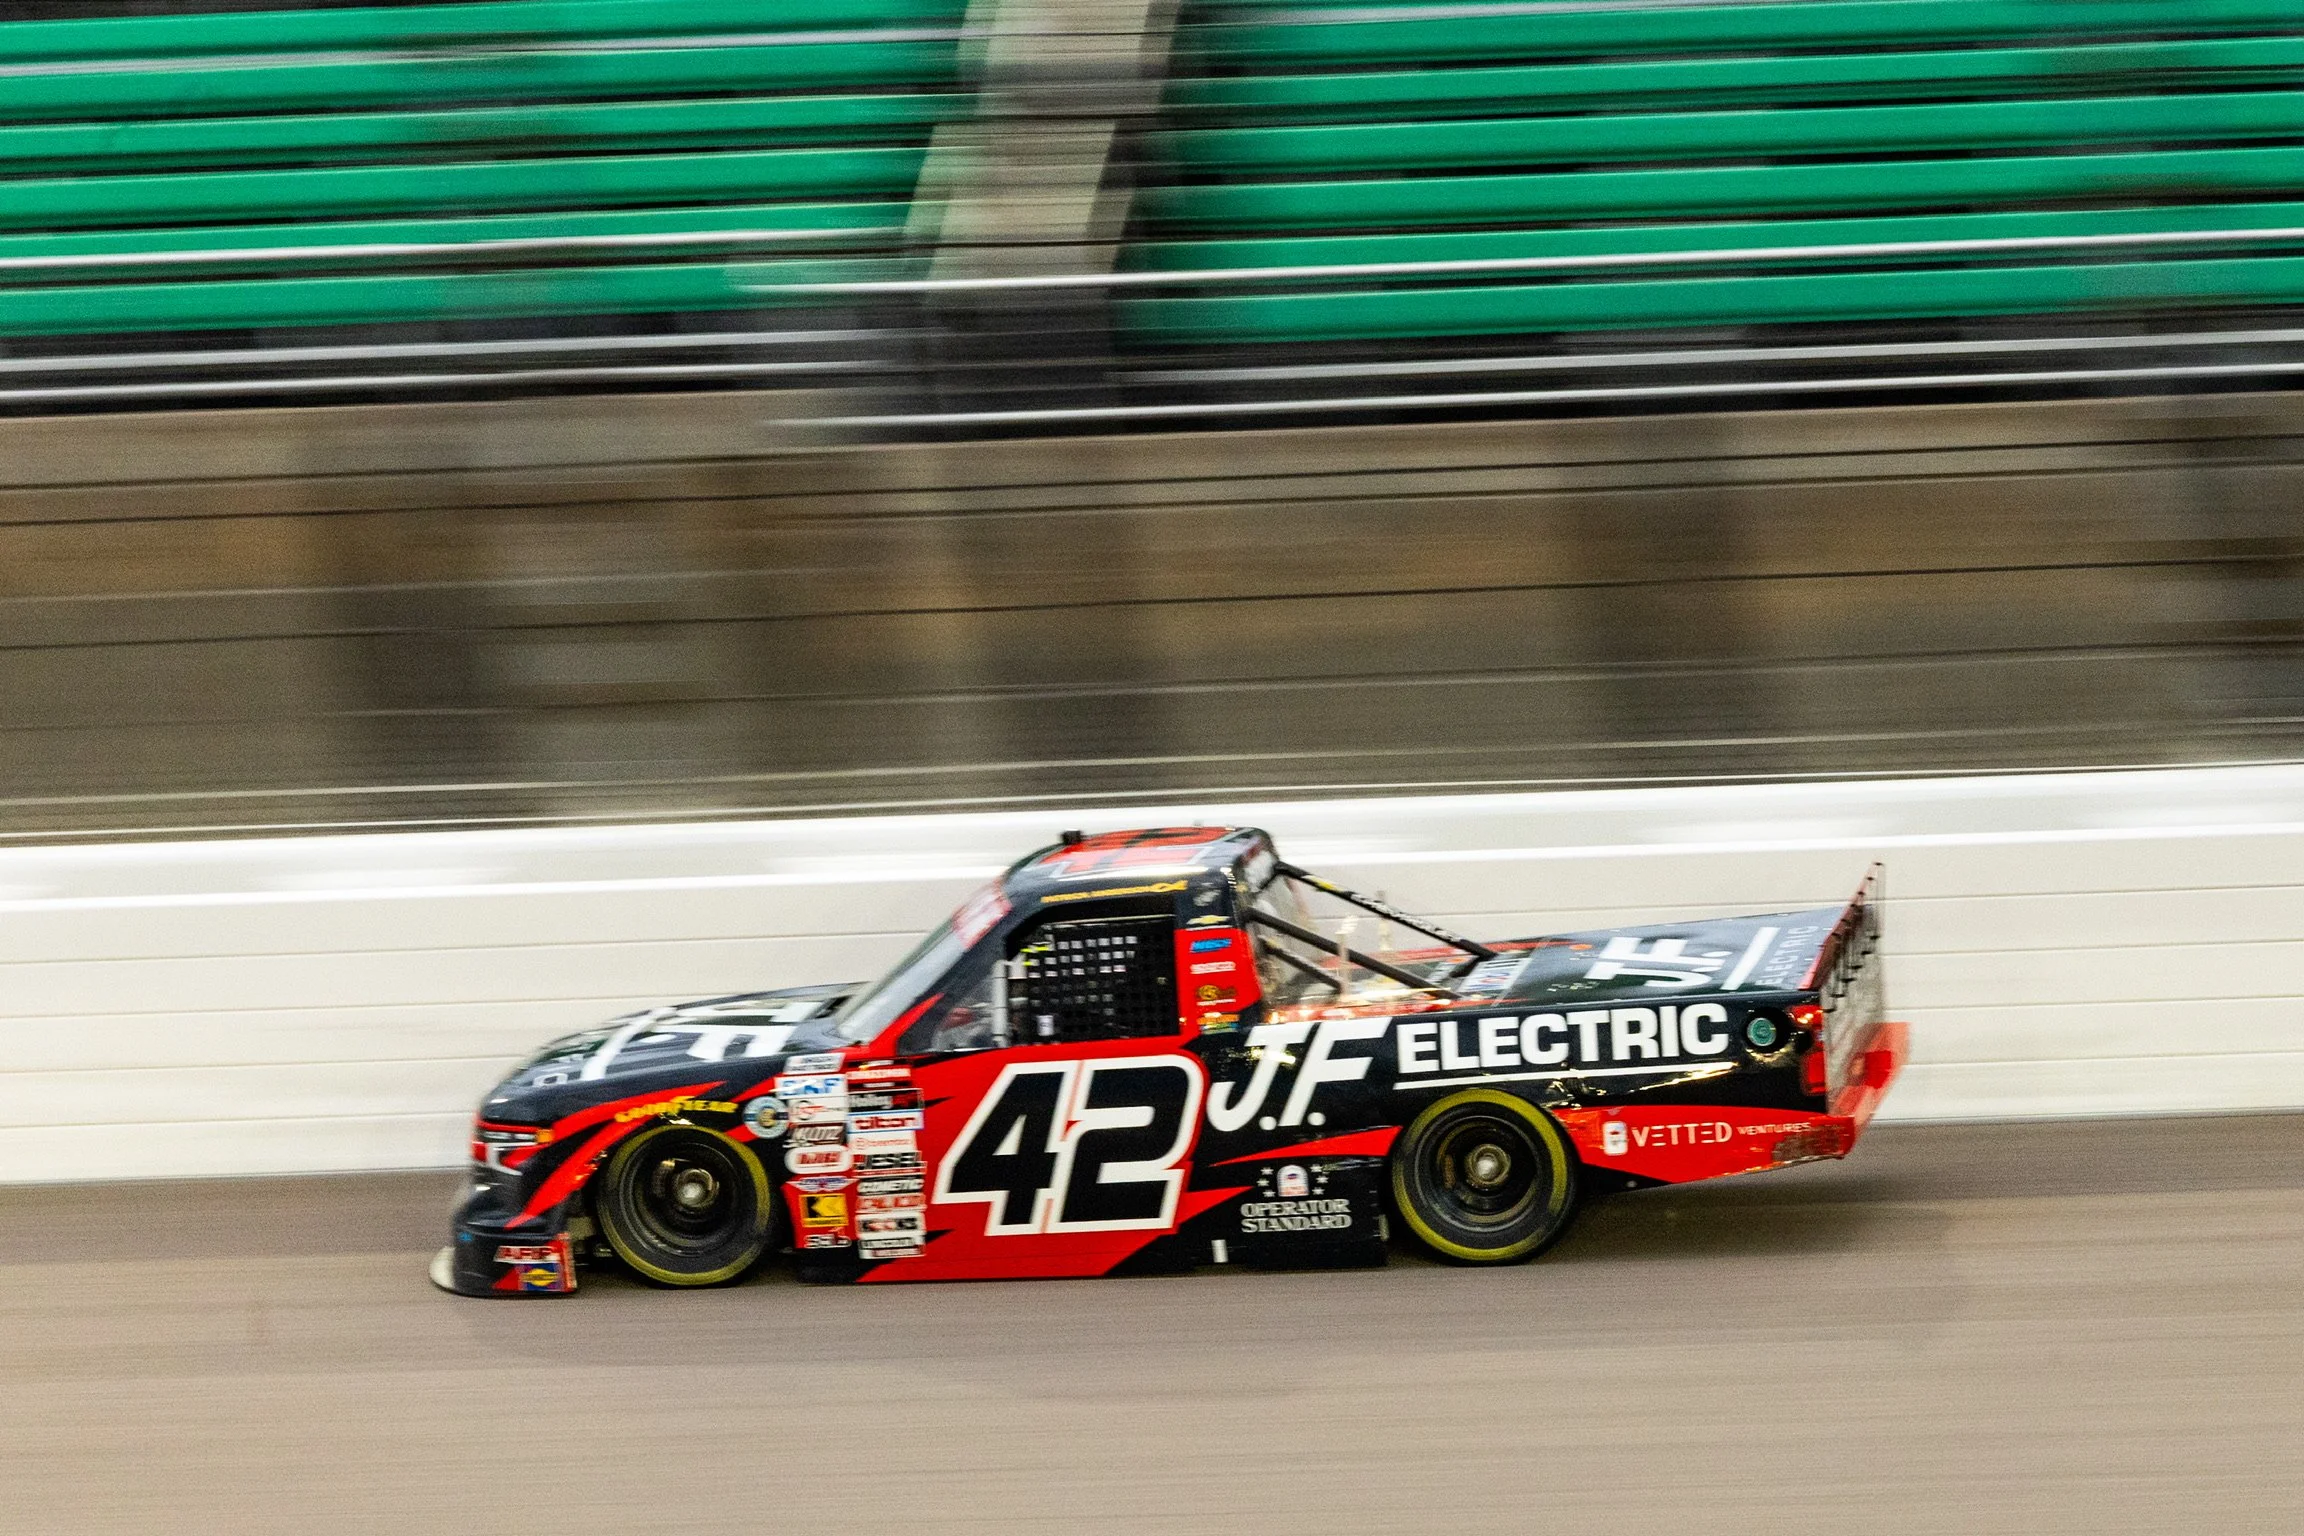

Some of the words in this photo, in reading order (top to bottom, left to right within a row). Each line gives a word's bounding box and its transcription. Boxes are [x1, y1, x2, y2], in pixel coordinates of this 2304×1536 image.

[1206, 1016, 1393, 1132] J.F.
[1397, 1002, 1730, 1074] ELECTRIC
[931, 1054, 1205, 1237] 42
[1632, 1121, 1733, 1148] VETTED
[1736, 1122, 1812, 1136] VENTURES
[1240, 1198, 1352, 1218] OPERATOR
[1241, 1214, 1353, 1234] STANDARD
